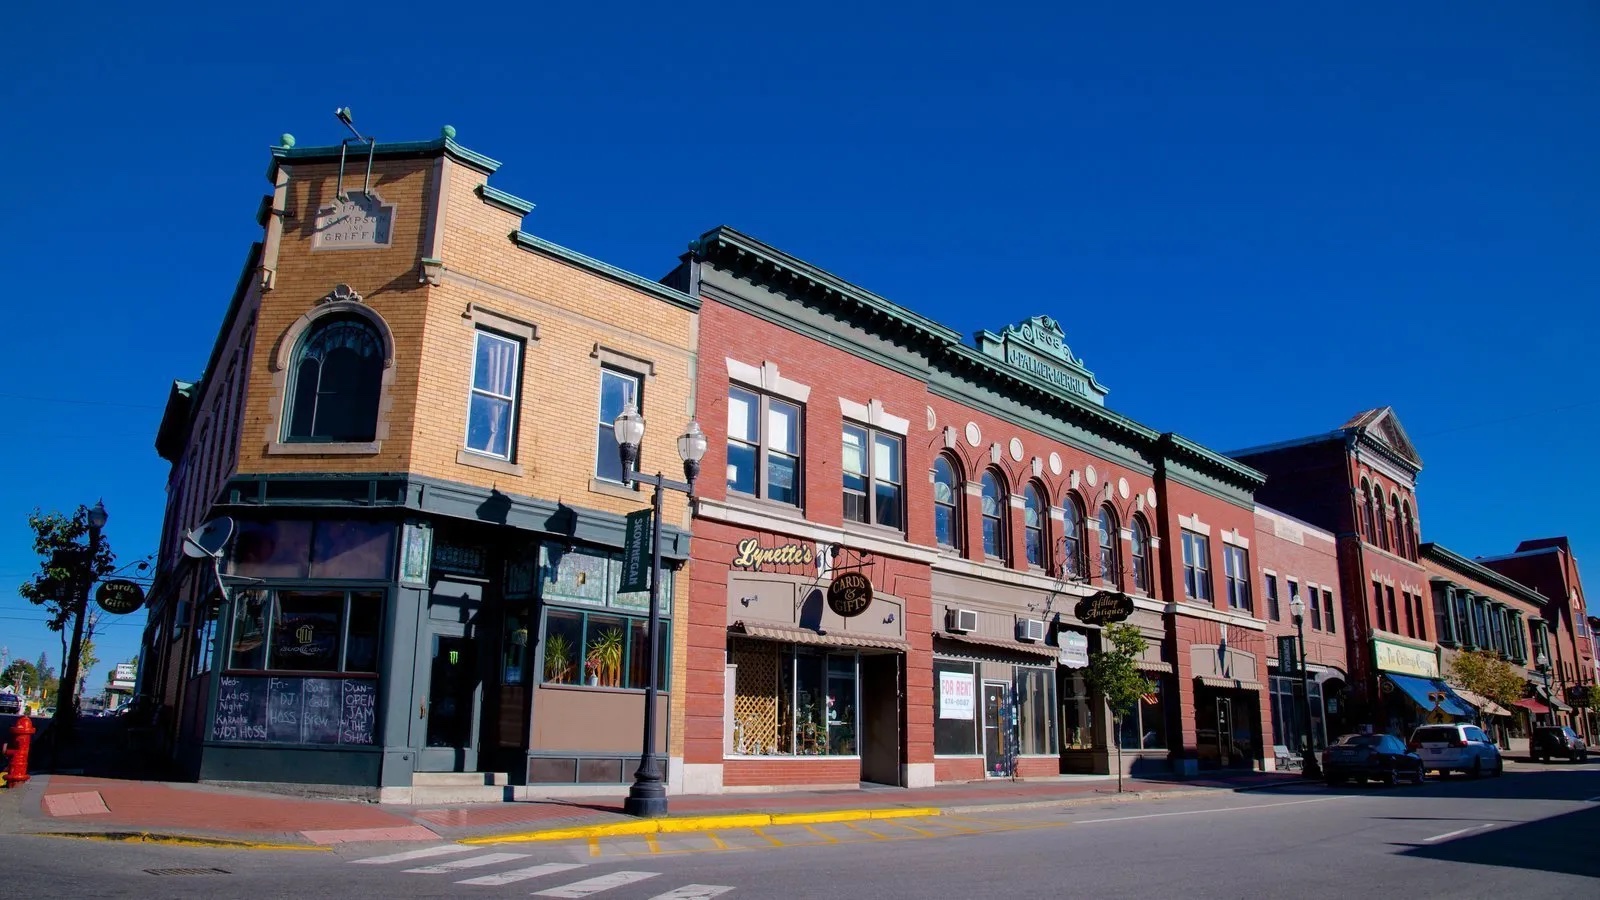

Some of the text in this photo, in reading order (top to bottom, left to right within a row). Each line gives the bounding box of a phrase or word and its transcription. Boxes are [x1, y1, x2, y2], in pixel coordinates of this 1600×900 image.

[324, 231, 386, 241] GRIFFIN
[628, 518, 643, 586] SKOWHEGAN
[734, 539, 813, 571] Lynette's
[105, 583, 135, 594] Cards
[833, 575, 866, 594] CARDS
[844, 588, 856, 601] &
[835, 594, 866, 613] GIFTS
[1086, 607, 1124, 620] Antiques
[942, 680, 972, 697] FOR RENT
[281, 692, 296, 706] DJ
[345, 694, 376, 707] OPEN
[270, 709, 297, 725] HOSS
[346, 706, 375, 724] JAM
[240, 725, 267, 738] HOSS
[351, 720, 367, 732] THE
